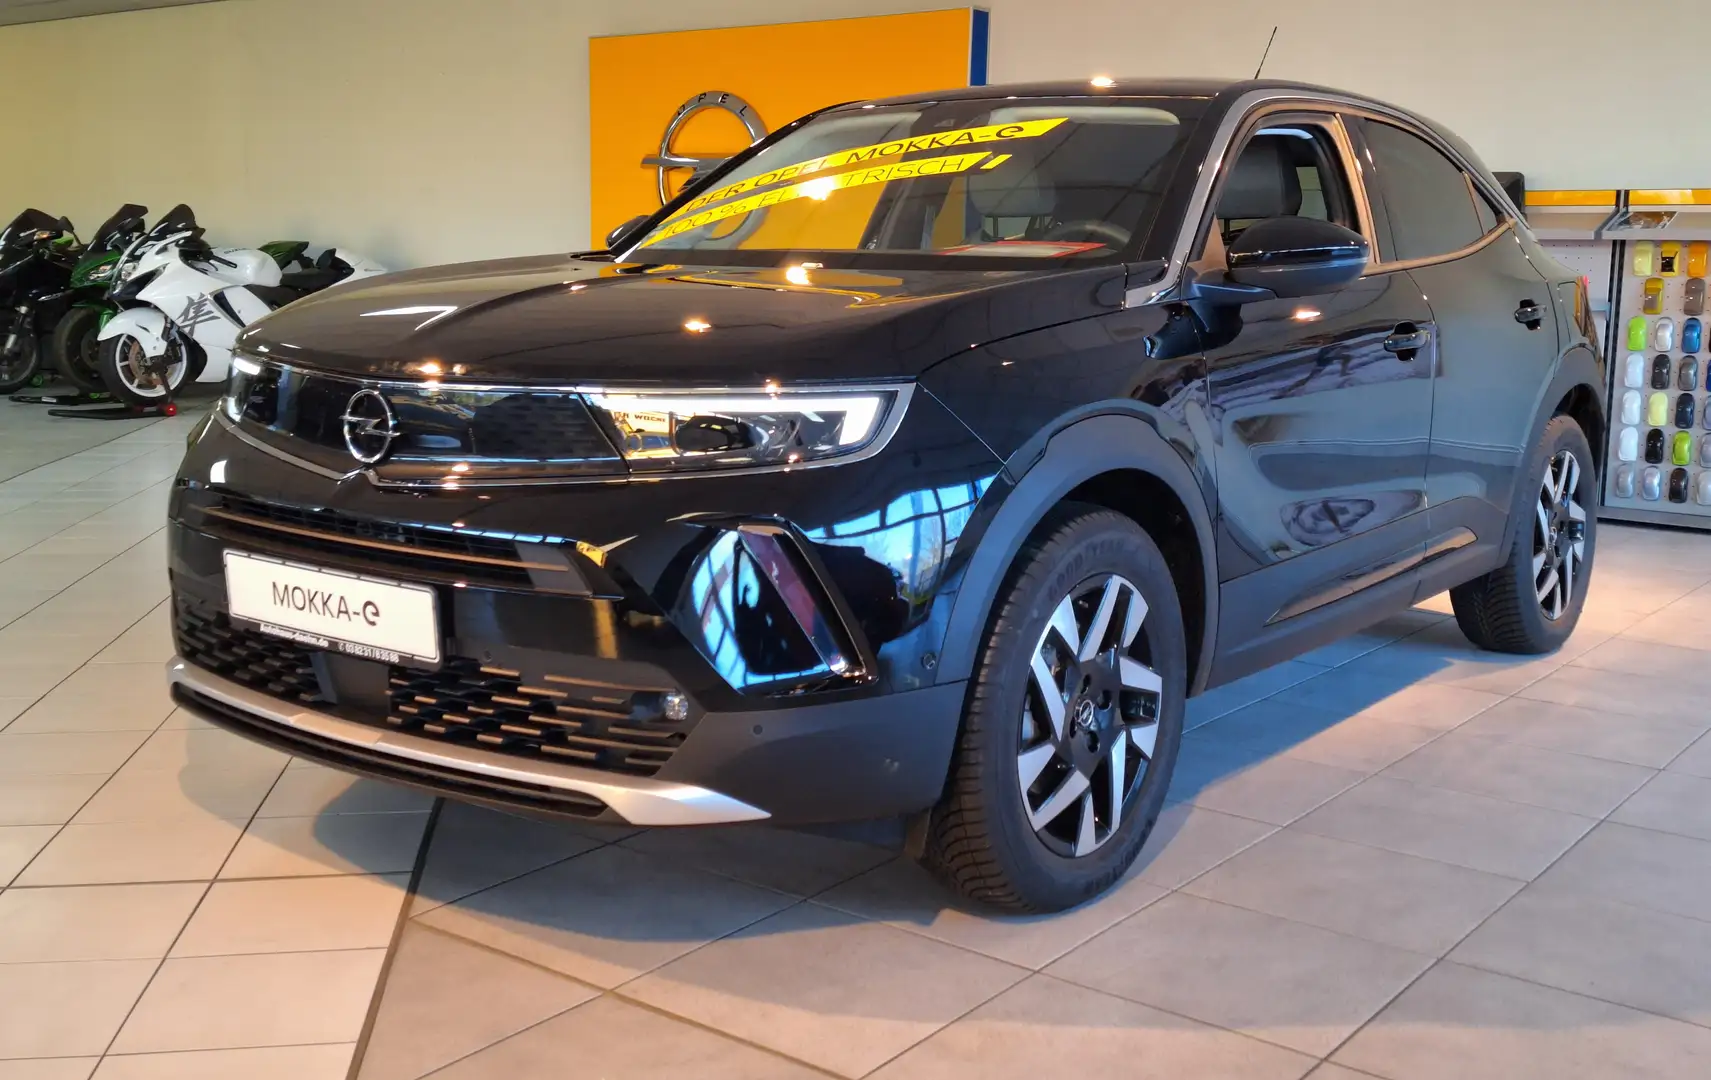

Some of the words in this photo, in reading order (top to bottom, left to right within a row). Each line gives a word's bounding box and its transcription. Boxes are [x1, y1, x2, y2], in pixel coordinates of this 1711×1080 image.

[677, 92, 748, 117] OPEL
[663, 211, 713, 238] 100
[758, 158, 965, 207] ELTRISCH
[686, 182, 746, 212] DER
[754, 158, 828, 188] OPEL
[846, 125, 1024, 164] MOKKA-e
[272, 581, 380, 627] MOKKA-e
